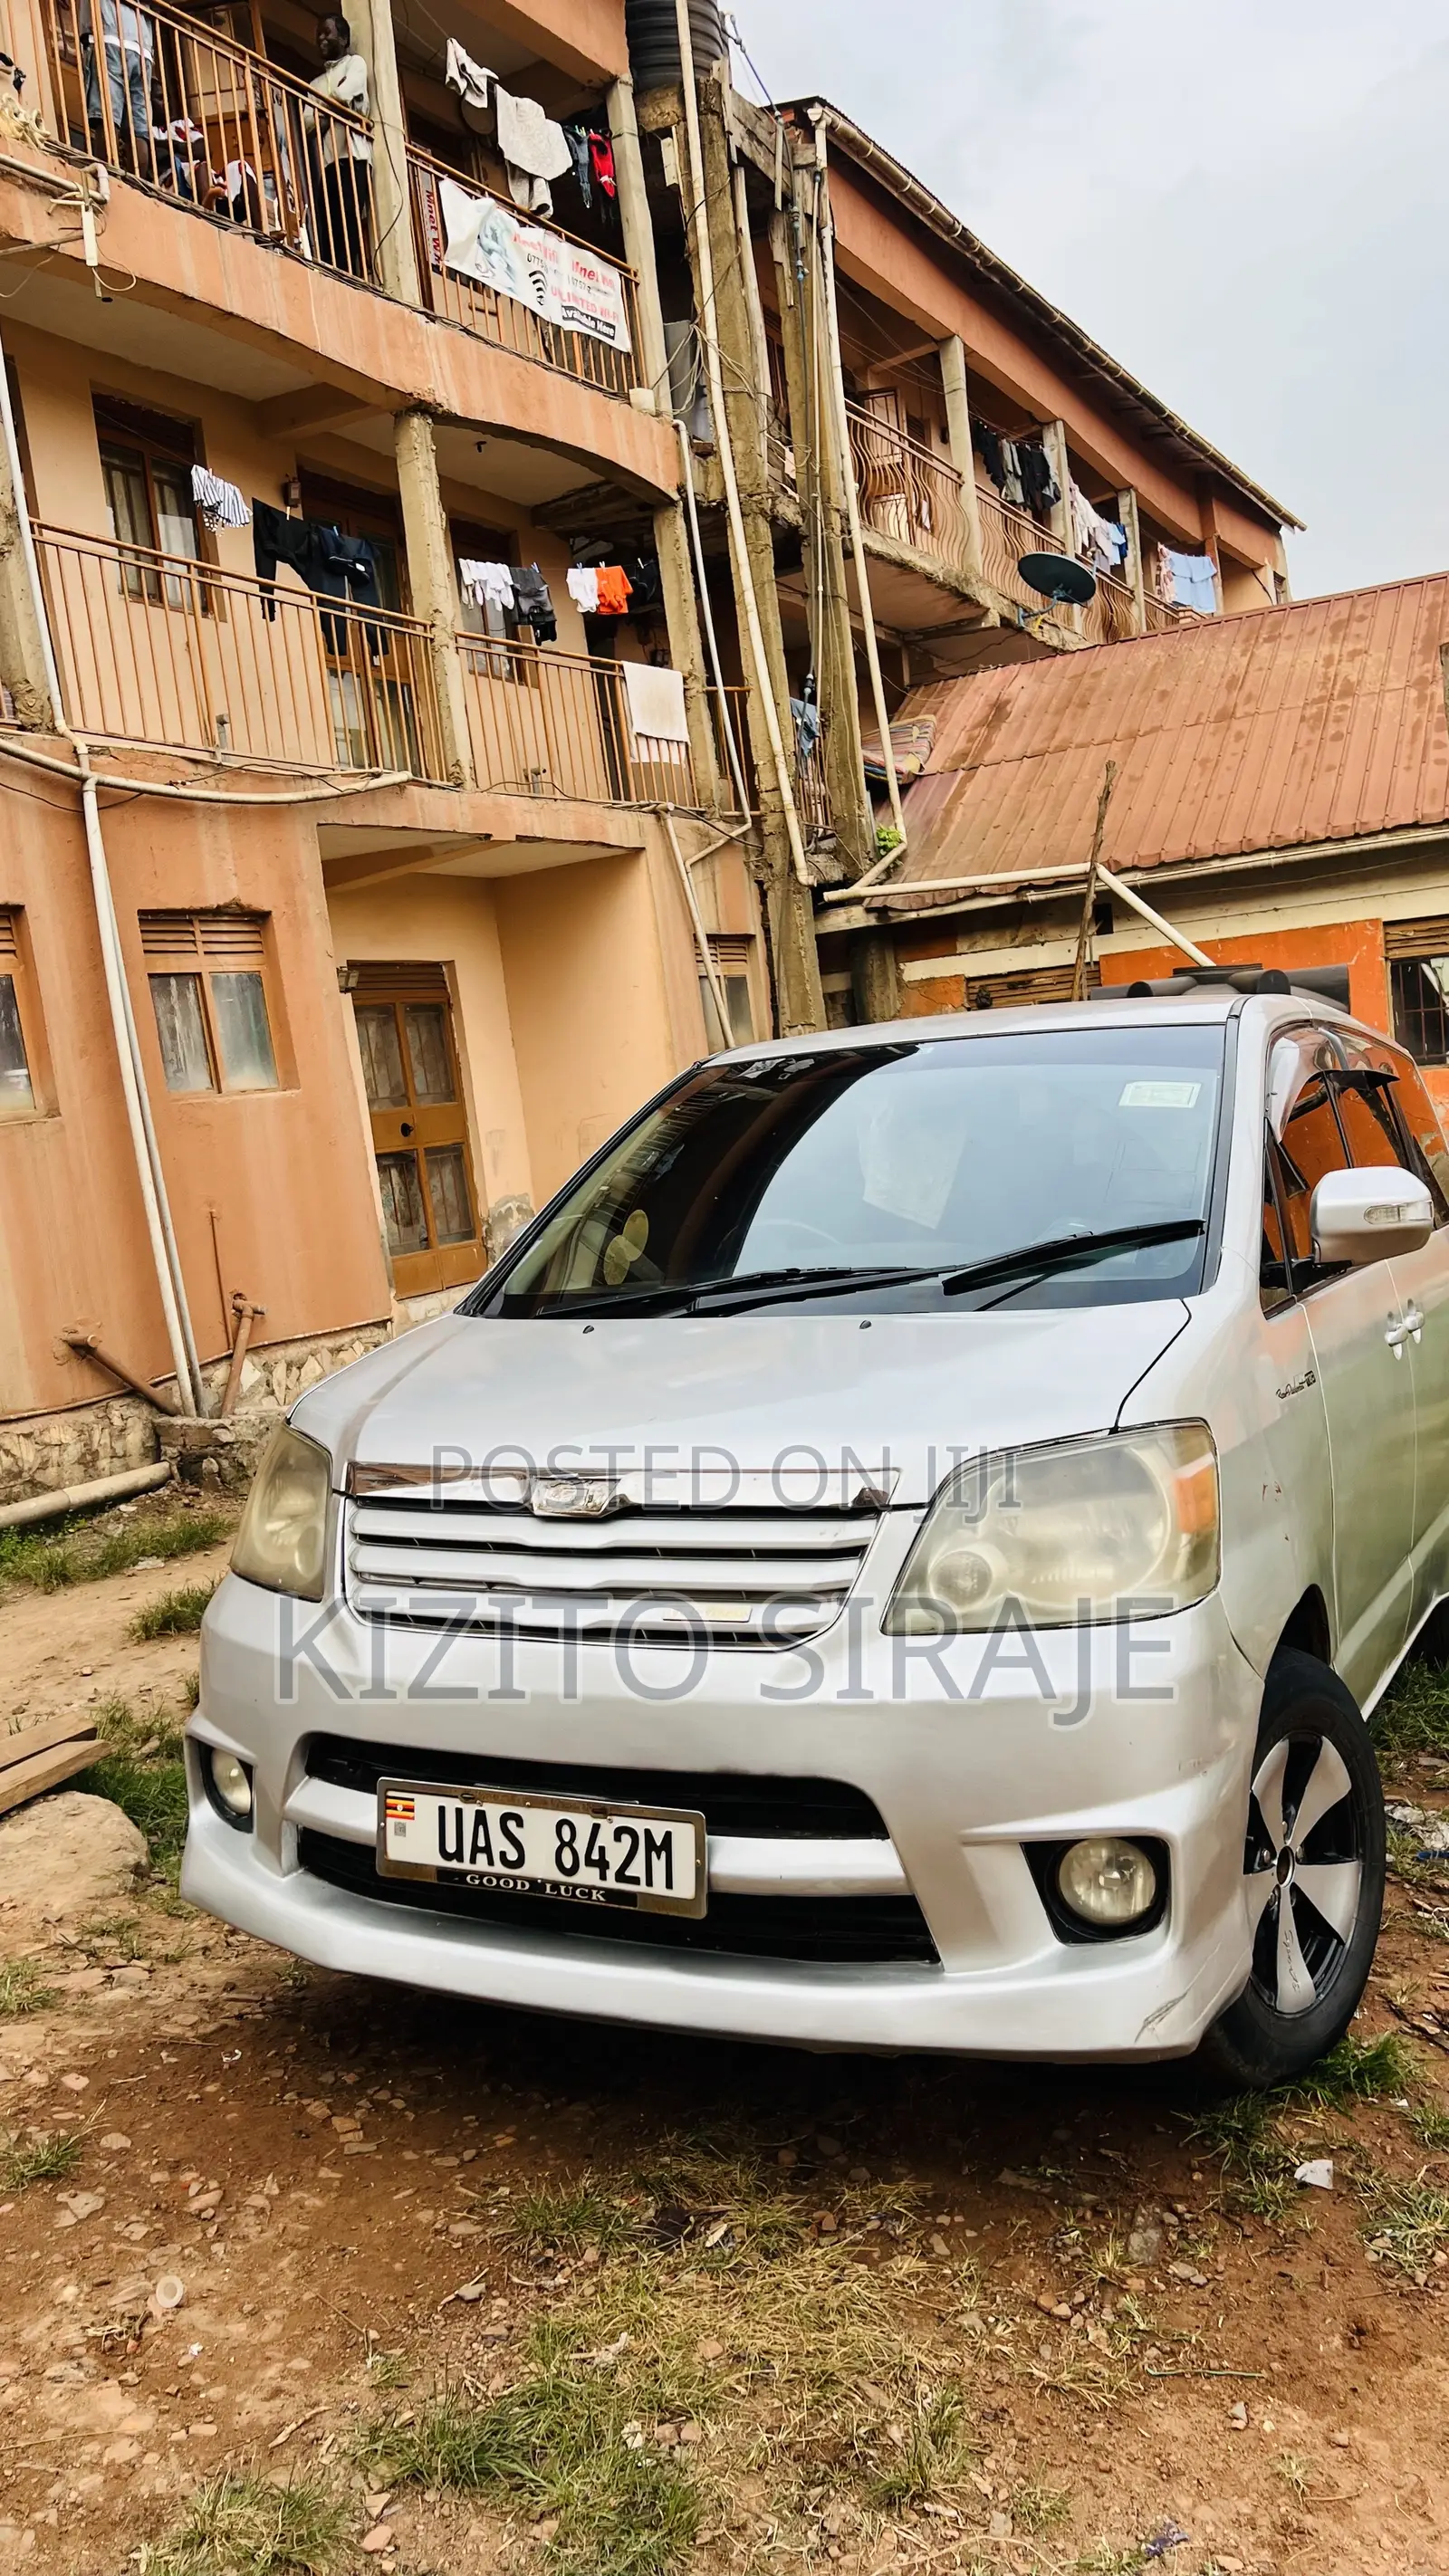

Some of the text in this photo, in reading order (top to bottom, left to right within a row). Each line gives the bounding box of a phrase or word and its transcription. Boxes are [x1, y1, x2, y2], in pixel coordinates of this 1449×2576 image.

[596, 320, 615, 337] Here
[438, 1805, 674, 1891] UAS 842M
[465, 1873, 607, 1902] GOOD LUCK
